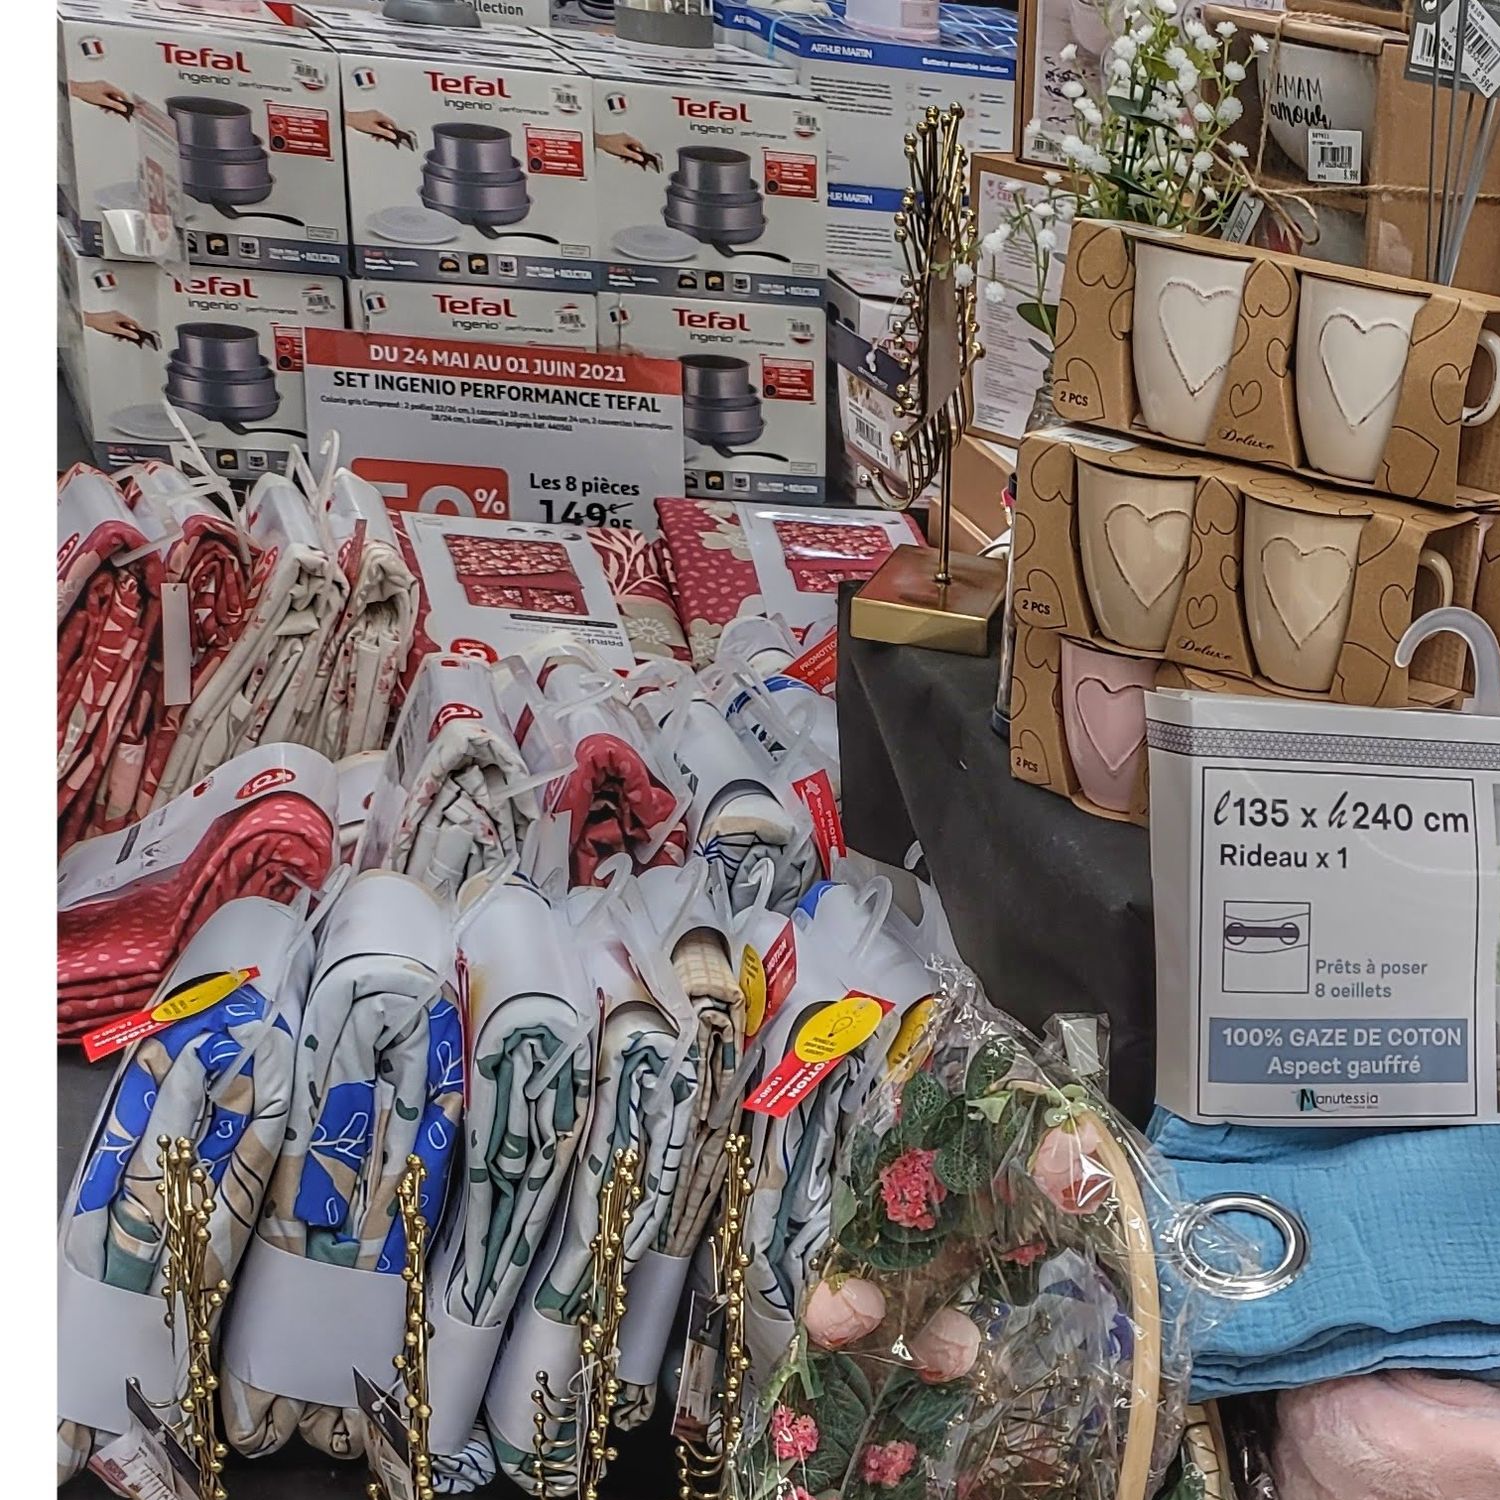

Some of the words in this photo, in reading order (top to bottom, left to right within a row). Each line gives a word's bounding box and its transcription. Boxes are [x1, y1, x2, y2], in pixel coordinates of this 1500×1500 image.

[155, 41, 252, 73] Tefal
[811, 43, 842, 55] ARTHUR
[843, 47, 872, 59] MARTIN
[178, 70, 231, 85] ingenio
[424, 70, 512, 98] Tefal
[444, 97, 492, 111] ingenio
[671, 96, 752, 123] Tefal
[690, 122, 734, 135] ingenio
[842, 194, 873, 205] MARTIN
[188, 299, 239, 312] ingenio
[432, 294, 517, 317] Tefal
[452, 318, 499, 331] ingenio
[672, 308, 750, 331] Tefal
[690, 332, 733, 344] ingenio
[370, 344, 398, 363] DU
[403, 348, 427, 366] 24
[432, 350, 470, 369] MAI
[473, 353, 501, 372] AU
[506, 356, 529, 374] 01
[533, 359, 576, 378] JUIN
[580, 363, 626, 382] 2021
[333, 371, 370, 389] SET
[375, 374, 456, 396] INGENIO
[460, 381, 601, 408] PERFORMANCE
[604, 393, 661, 413] TEFAL
[1059, 391, 1066, 402] 2
[1068, 393, 1088, 407] PCS
[1218, 428, 1275, 450] Deluxe
[530, 473, 561, 491] Les
[566, 476, 576, 492] 8
[582, 476, 639, 497] pièces
[1022, 599, 1028, 610] 2
[1031, 601, 1050, 615] PCS
[800, 638, 838, 671] PROMOTIO
[1178, 637, 1233, 660] Deluxe
[1016, 756, 1021, 766] 2
[1023, 759, 1038, 773] PCS
[1300, 808, 1318, 828] x
[1424, 811, 1469, 833] cm
[1220, 843, 1308, 869] Rideau
[1315, 852, 1329, 868] x
[1337, 847, 1348, 868] 1
[1315, 957, 1360, 977] Prêts
[1365, 957, 1376, 976] à
[1381, 962, 1427, 980] poser
[1315, 984, 1324, 998] 8
[1327, 982, 1391, 999] oeillets
[1222, 1027, 1283, 1048] 100%
[1289, 1027, 1346, 1048] GAZE
[1354, 1028, 1382, 1047] DE
[1387, 1027, 1462, 1047] COTON
[1267, 1055, 1341, 1078] Aspect
[1347, 1053, 1421, 1078] gauffré
[1299, 1087, 1379, 1111] Manutessia
